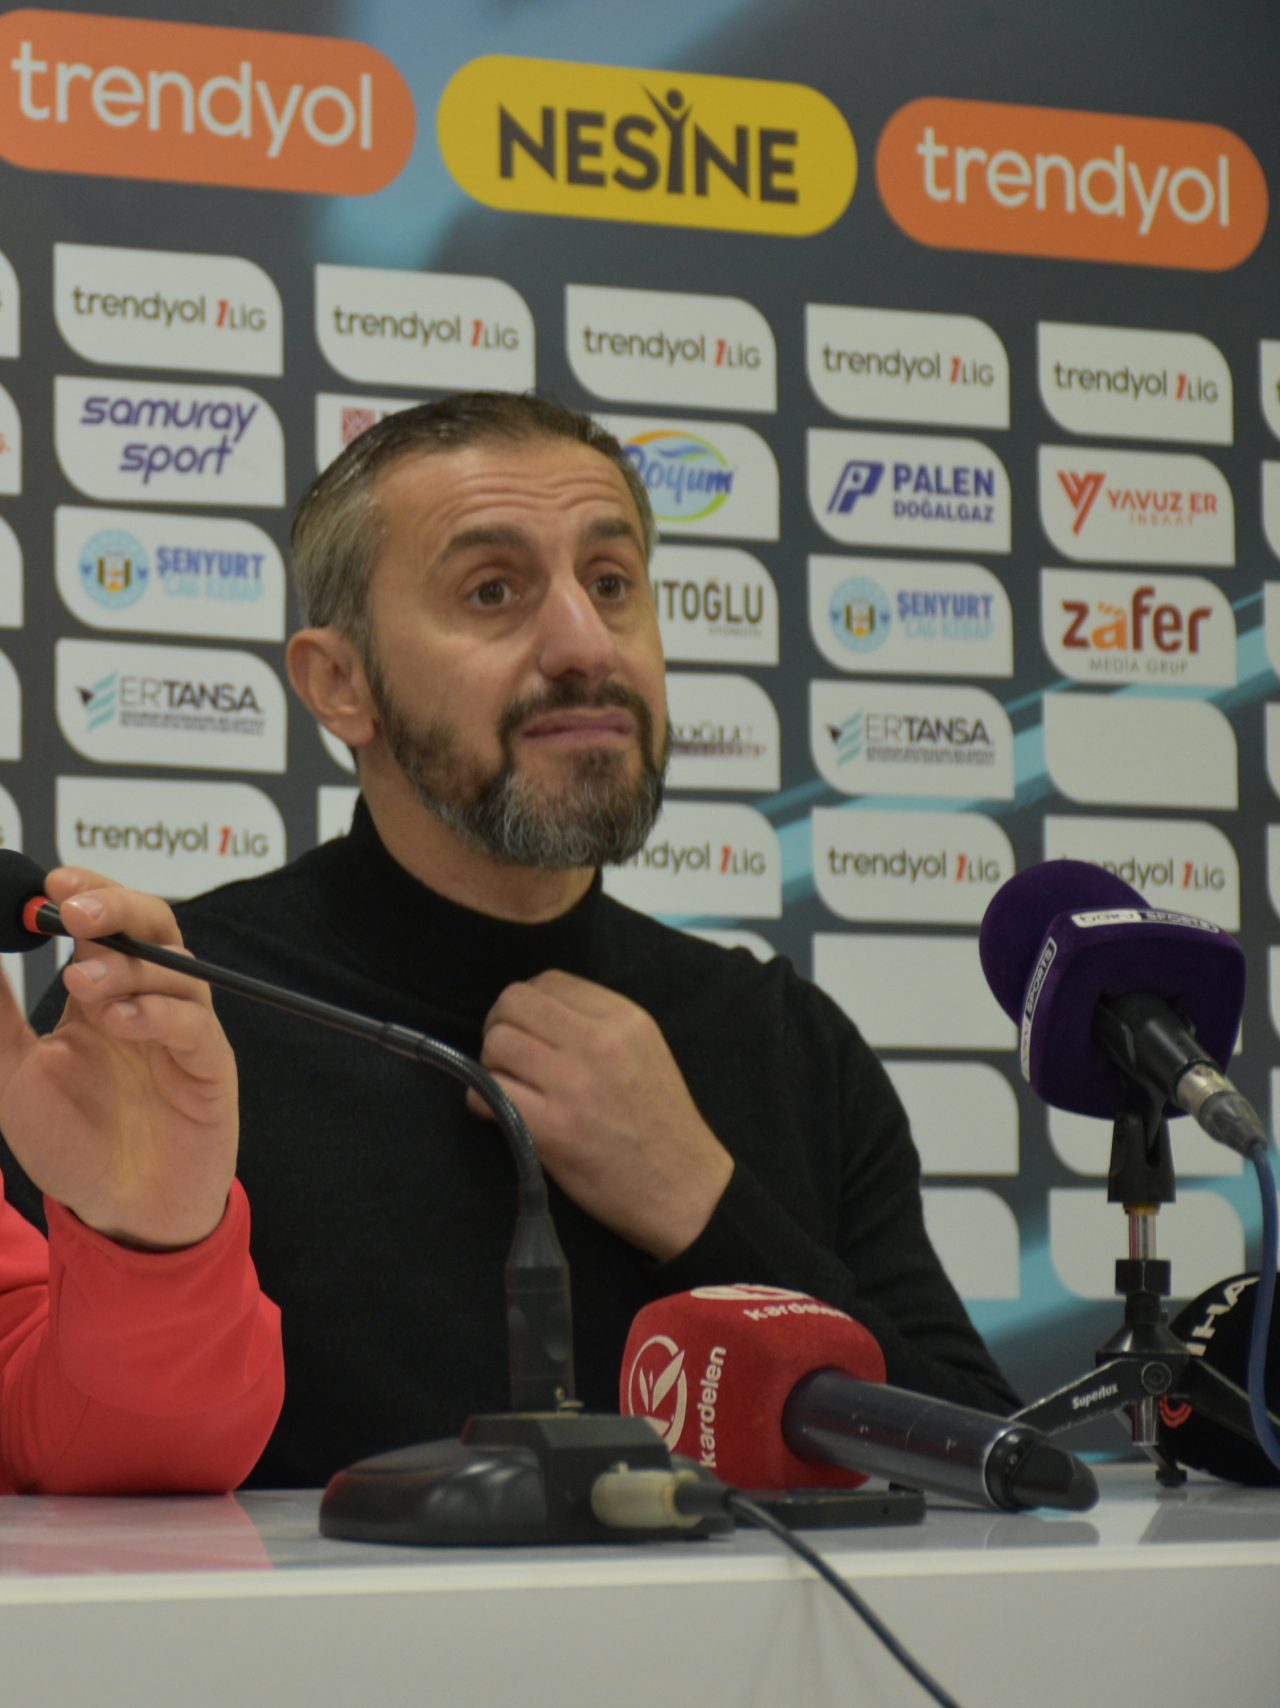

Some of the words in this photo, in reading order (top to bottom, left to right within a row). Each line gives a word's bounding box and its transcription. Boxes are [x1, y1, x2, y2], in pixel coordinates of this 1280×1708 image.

[11, 40, 373, 159] trendyol
[916, 126, 1230, 236] trendyol
[73, 286, 206, 327] trendyol
[333, 307, 461, 349] trendyol
[583, 325, 706, 366] trendyol
[822, 344, 941, 384] trendyol
[1054, 361, 1168, 400] trendyol
[80, 395, 259, 444] samuray
[119, 436, 234, 485] sport
[893, 464, 995, 498] PALEN
[1107, 488, 1184, 513] YAVUZ
[1190, 492, 1218, 514] ER
[893, 499, 995, 524] DOĞALGAZ
[157, 545, 265, 579] ŞENYURT
[897, 590, 995, 621] ŞENYURT
[1061, 586, 1213, 655] zafer
[120, 675, 261, 715] ERTANSA
[865, 713, 991, 746] ERTANSA
[76, 818, 209, 858] trendyol
[828, 846, 947, 884] trendyol
[698, 1345, 727, 1468] kardelen
[1072, 1383, 1119, 1410] Superlux
